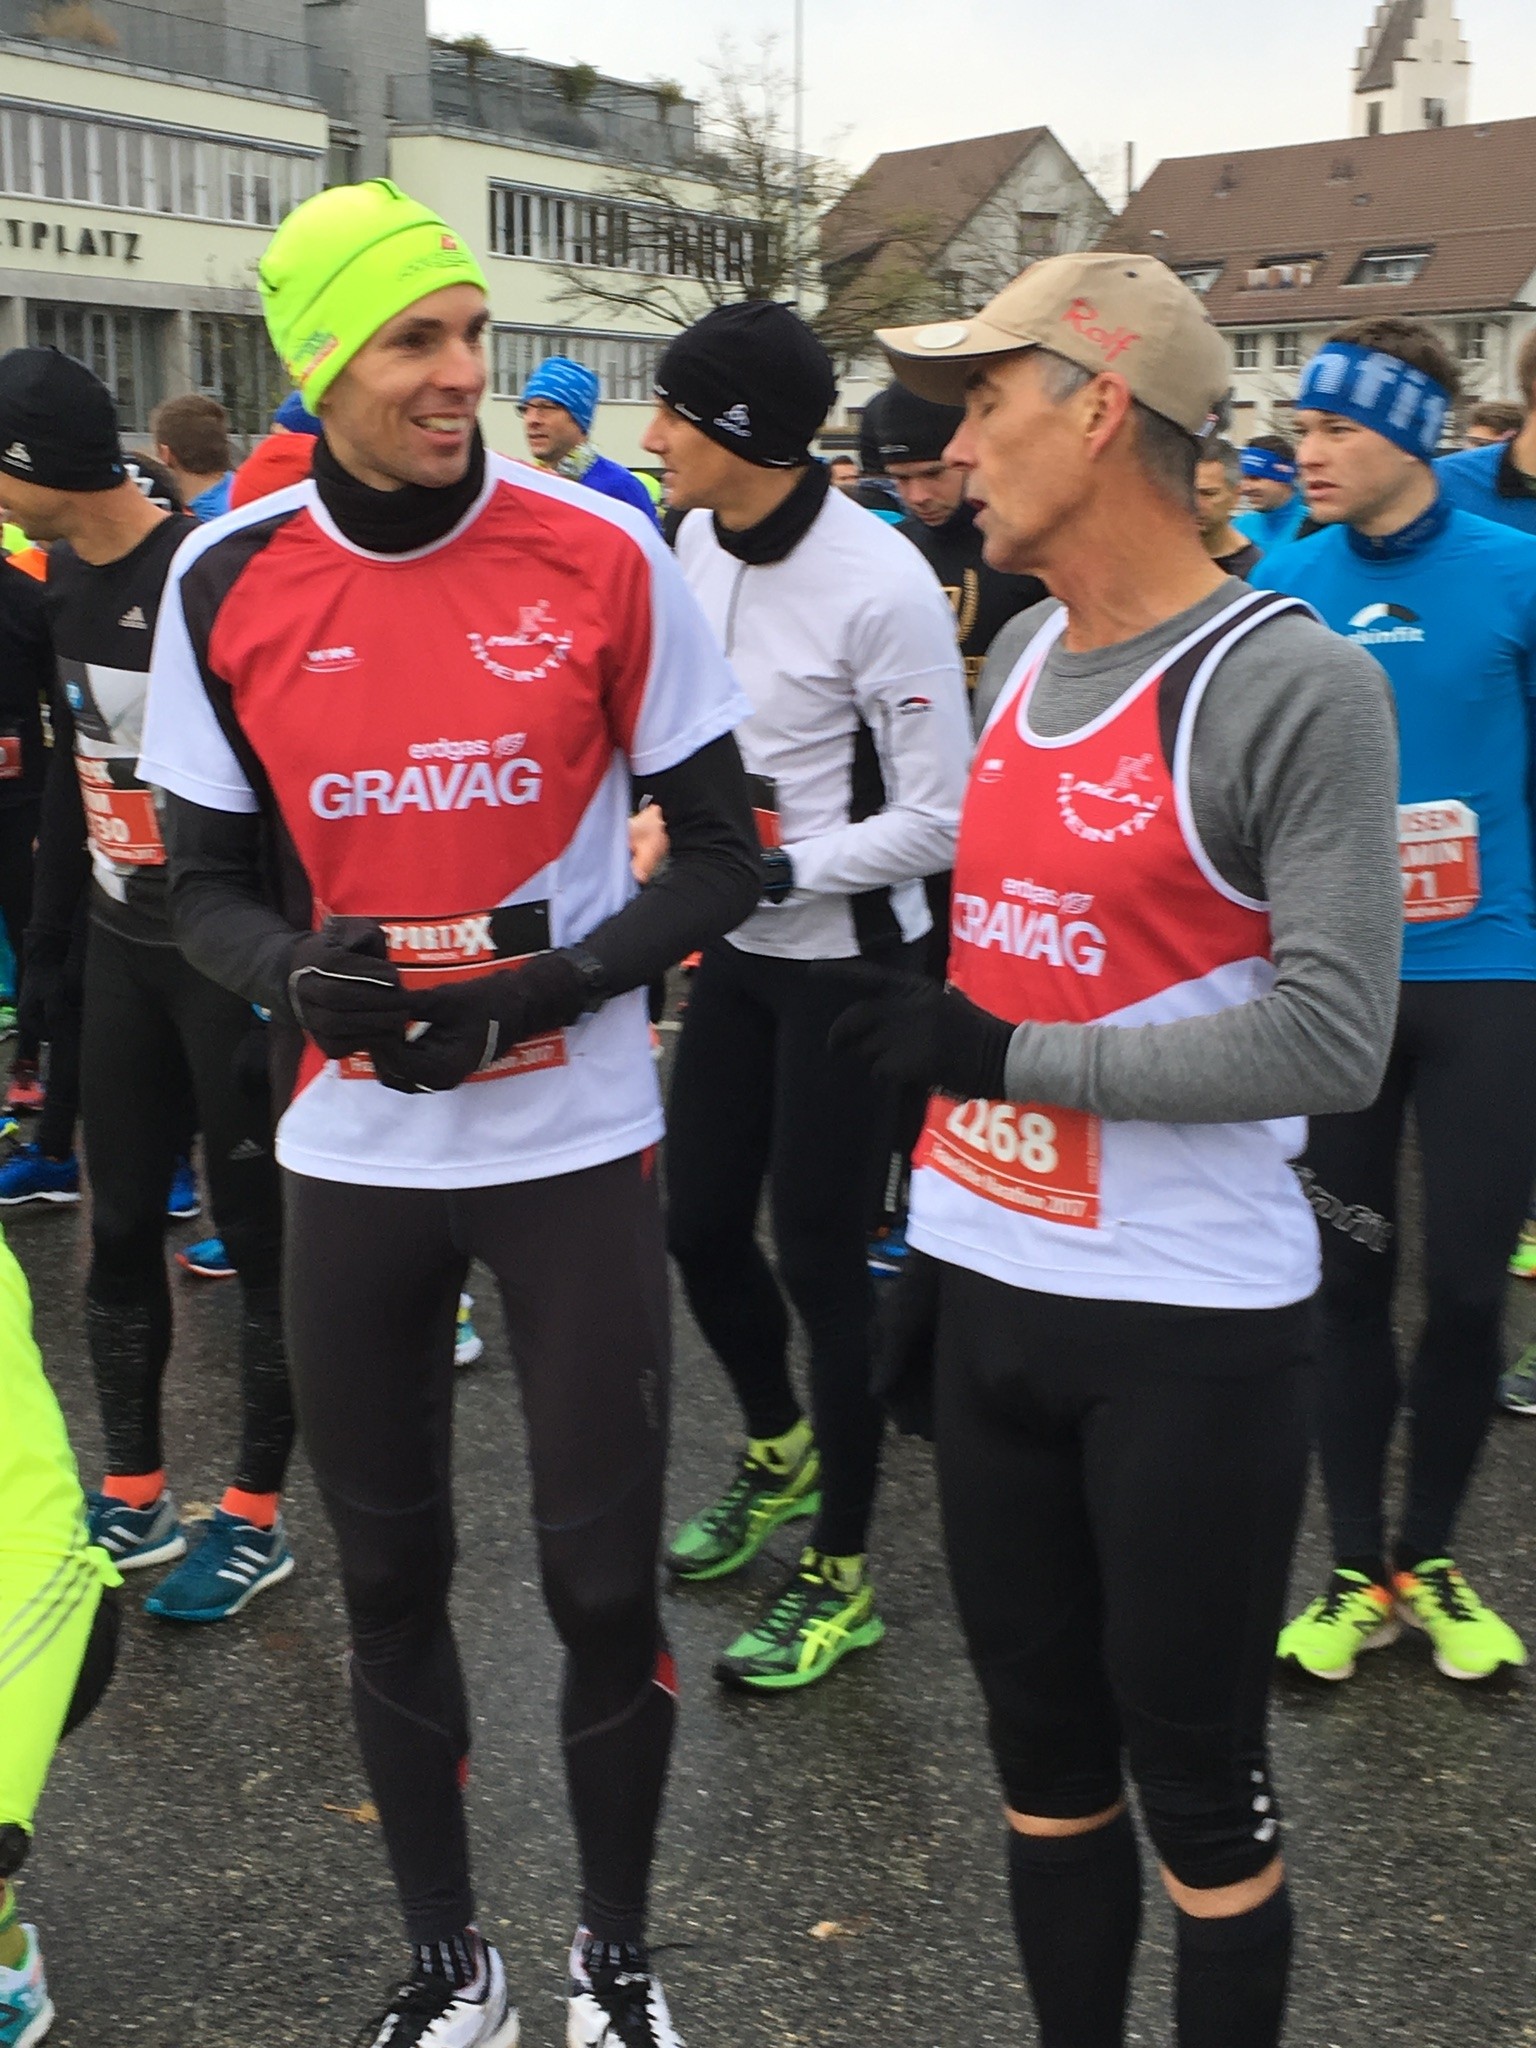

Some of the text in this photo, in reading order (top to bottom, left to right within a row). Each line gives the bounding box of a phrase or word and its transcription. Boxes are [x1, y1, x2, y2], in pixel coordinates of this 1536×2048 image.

[0, 218, 143, 263] TPLATZ
[1060, 296, 1142, 362] Rolf
[408, 737, 490, 761] erdgas
[308, 757, 543, 821] GRAVAG
